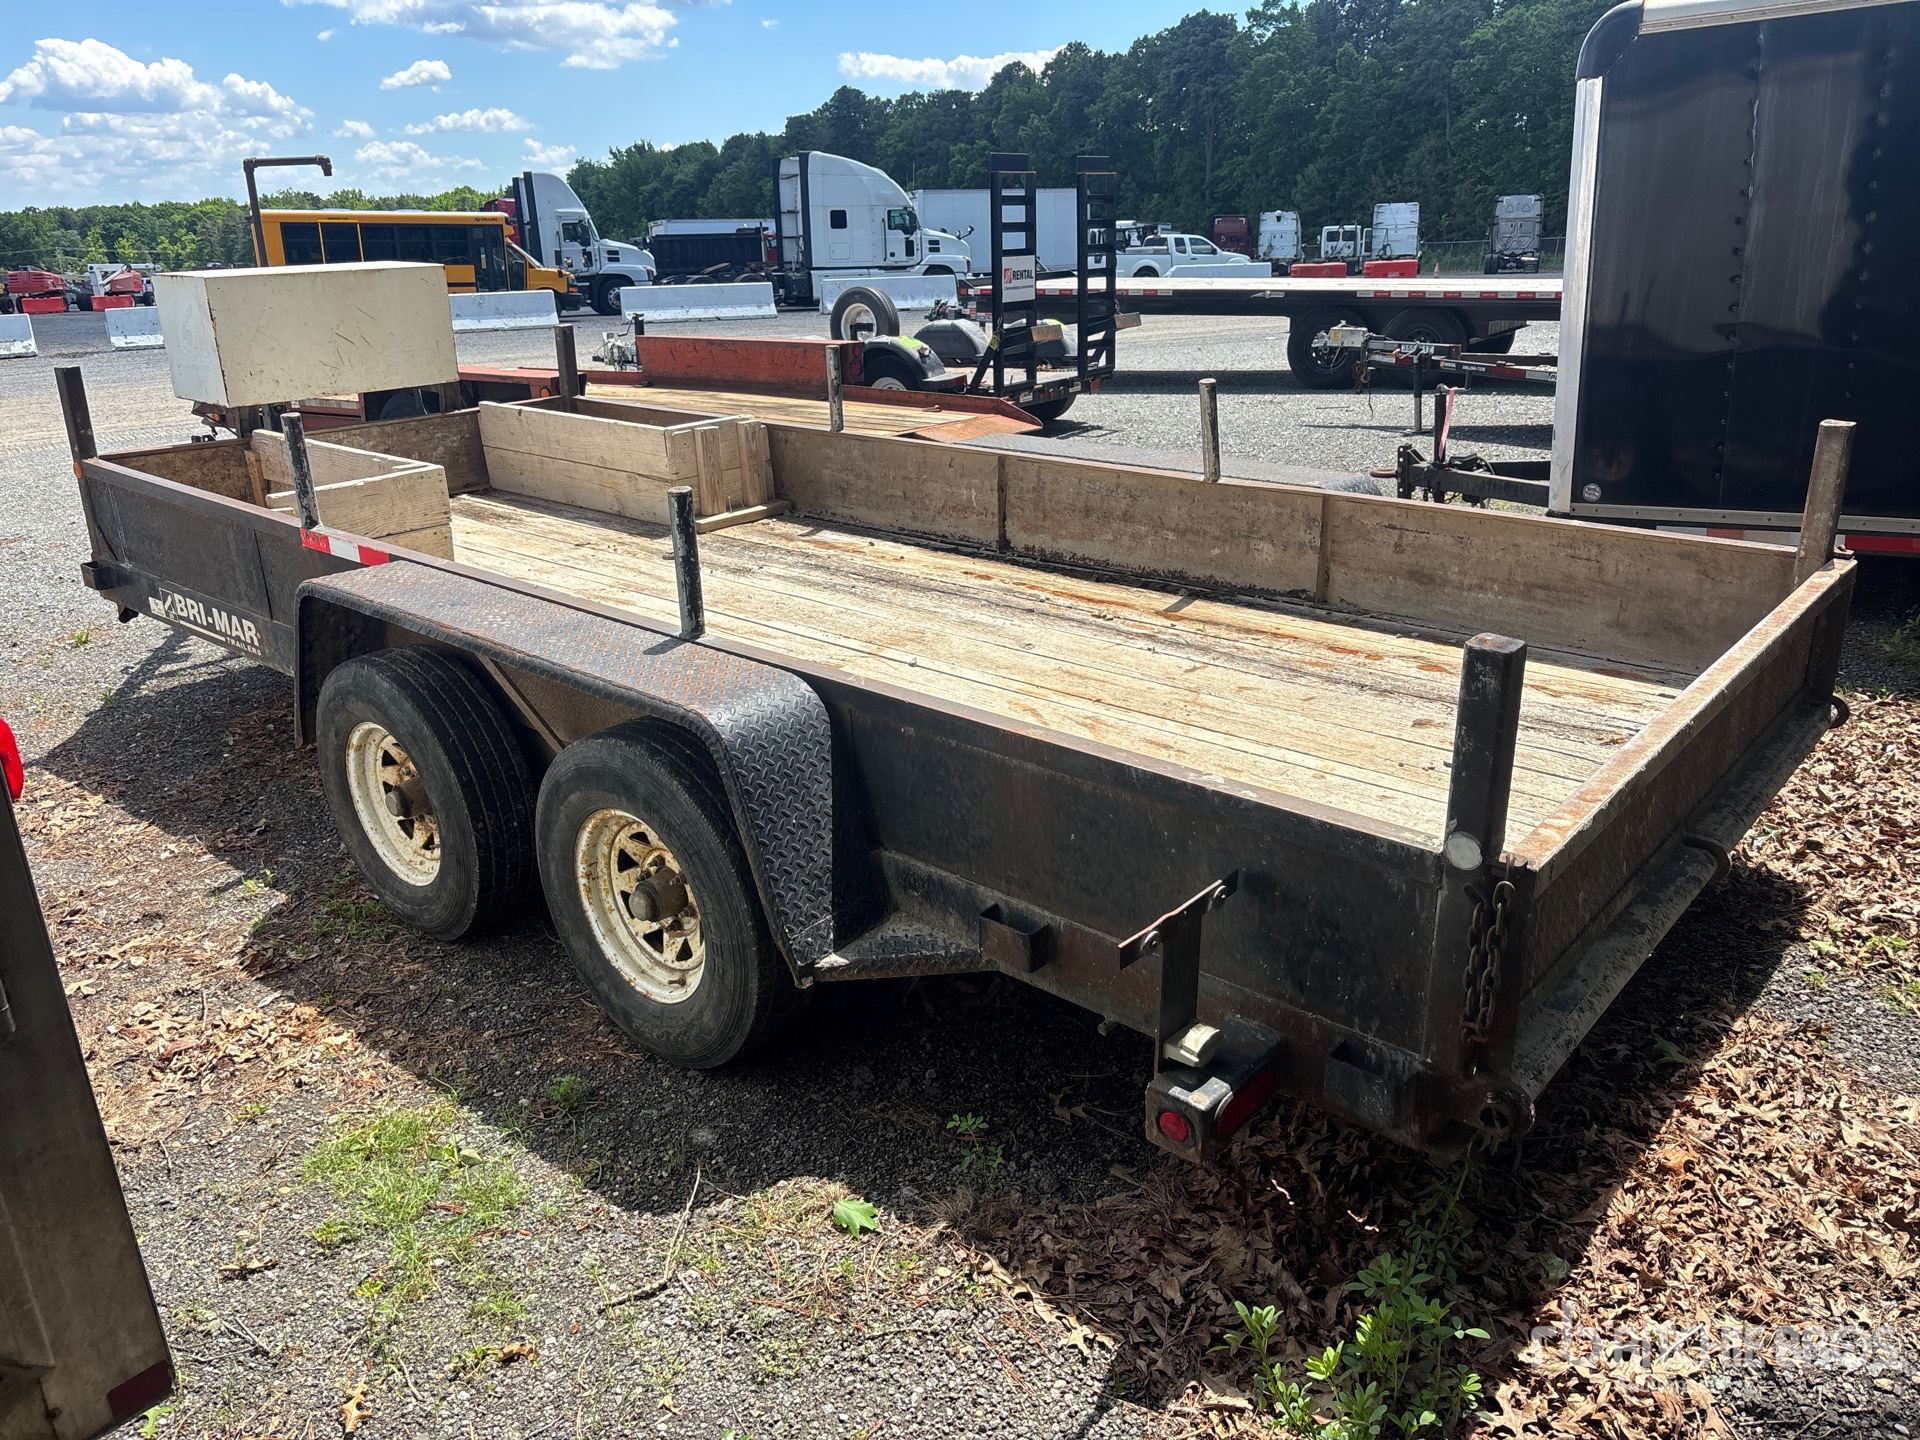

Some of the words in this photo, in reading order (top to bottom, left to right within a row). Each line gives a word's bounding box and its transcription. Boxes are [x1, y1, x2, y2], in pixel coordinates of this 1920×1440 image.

[1012, 269, 1034, 280] RENTAL
[174, 592, 260, 647] BRI-MAR
[226, 636, 262, 656] TRAILERS
